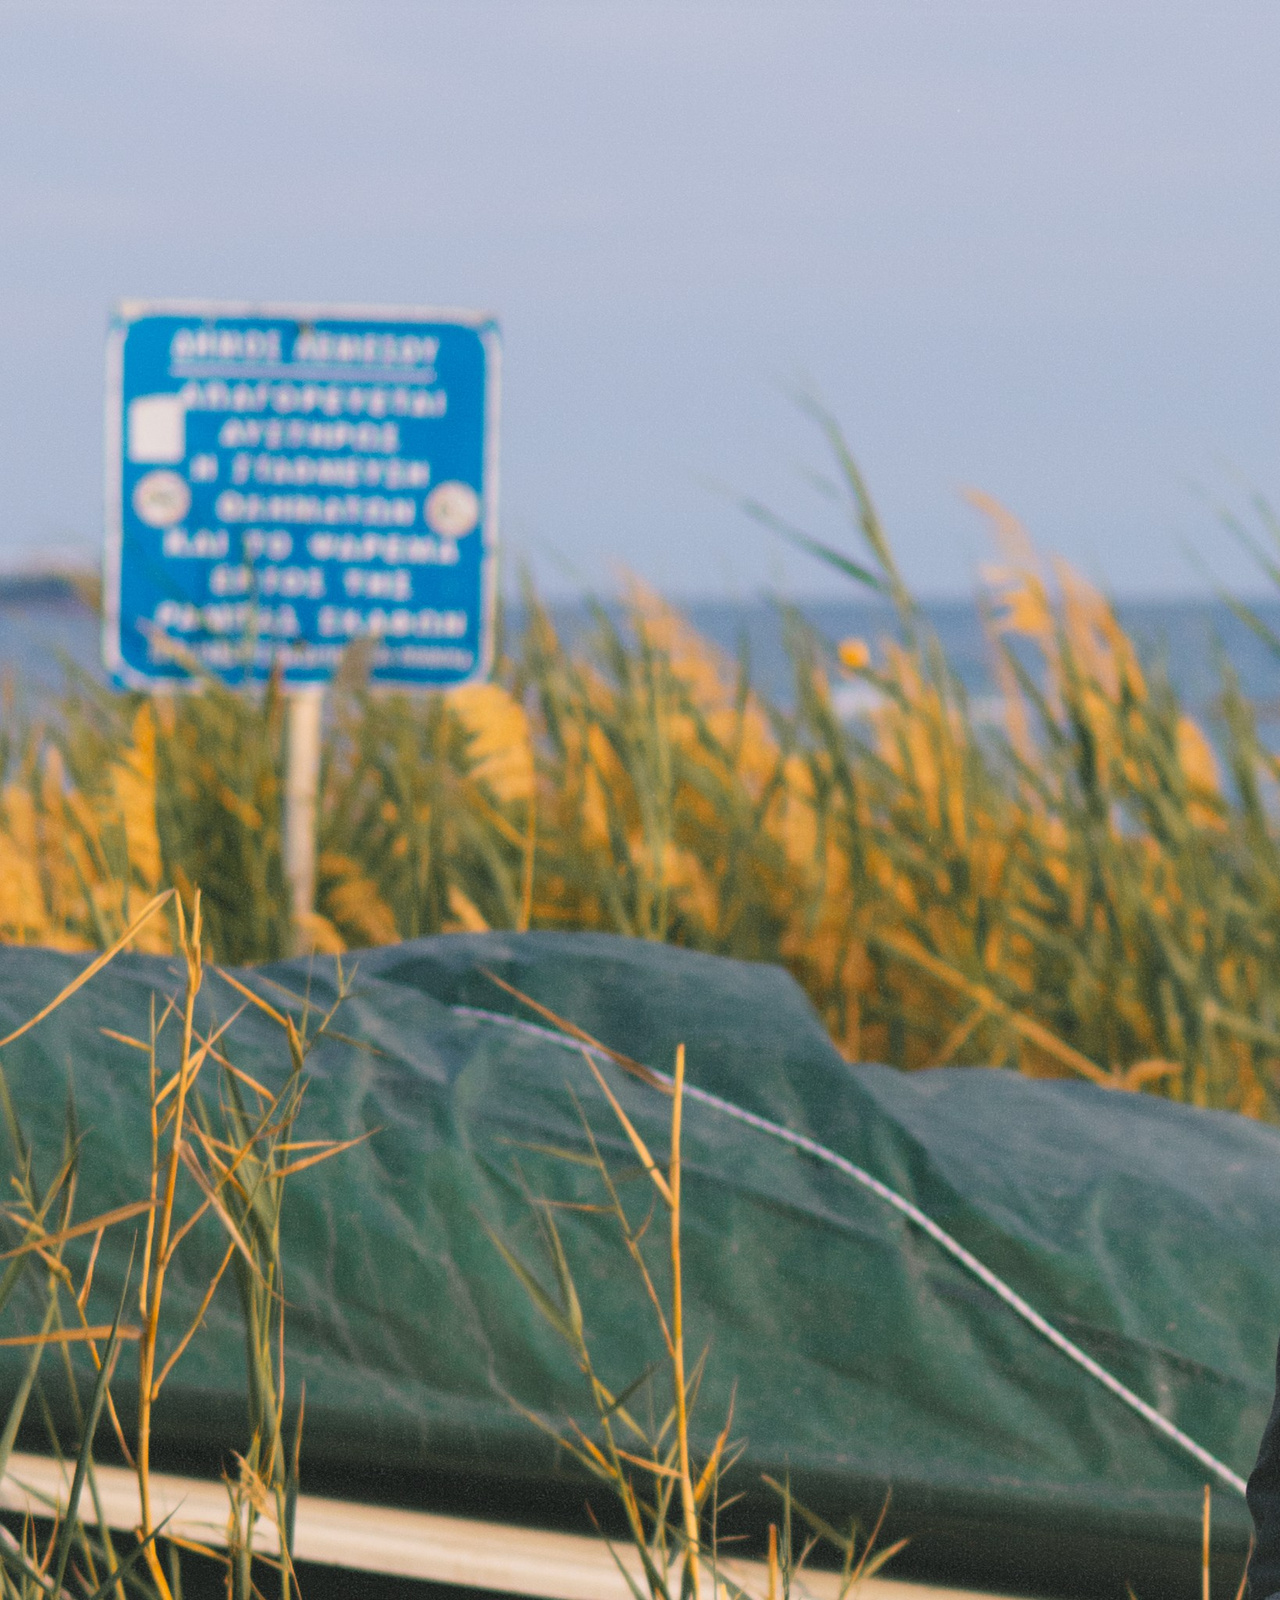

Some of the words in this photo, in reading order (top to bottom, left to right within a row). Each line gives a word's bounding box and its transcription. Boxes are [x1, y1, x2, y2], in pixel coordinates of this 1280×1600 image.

[181, 381, 447, 418] ΑΠΑΓΟΡΕΥΕΤΑΙ
[163, 528, 229, 558] ΚΑΙ
[243, 528, 293, 560] ΤΟ
